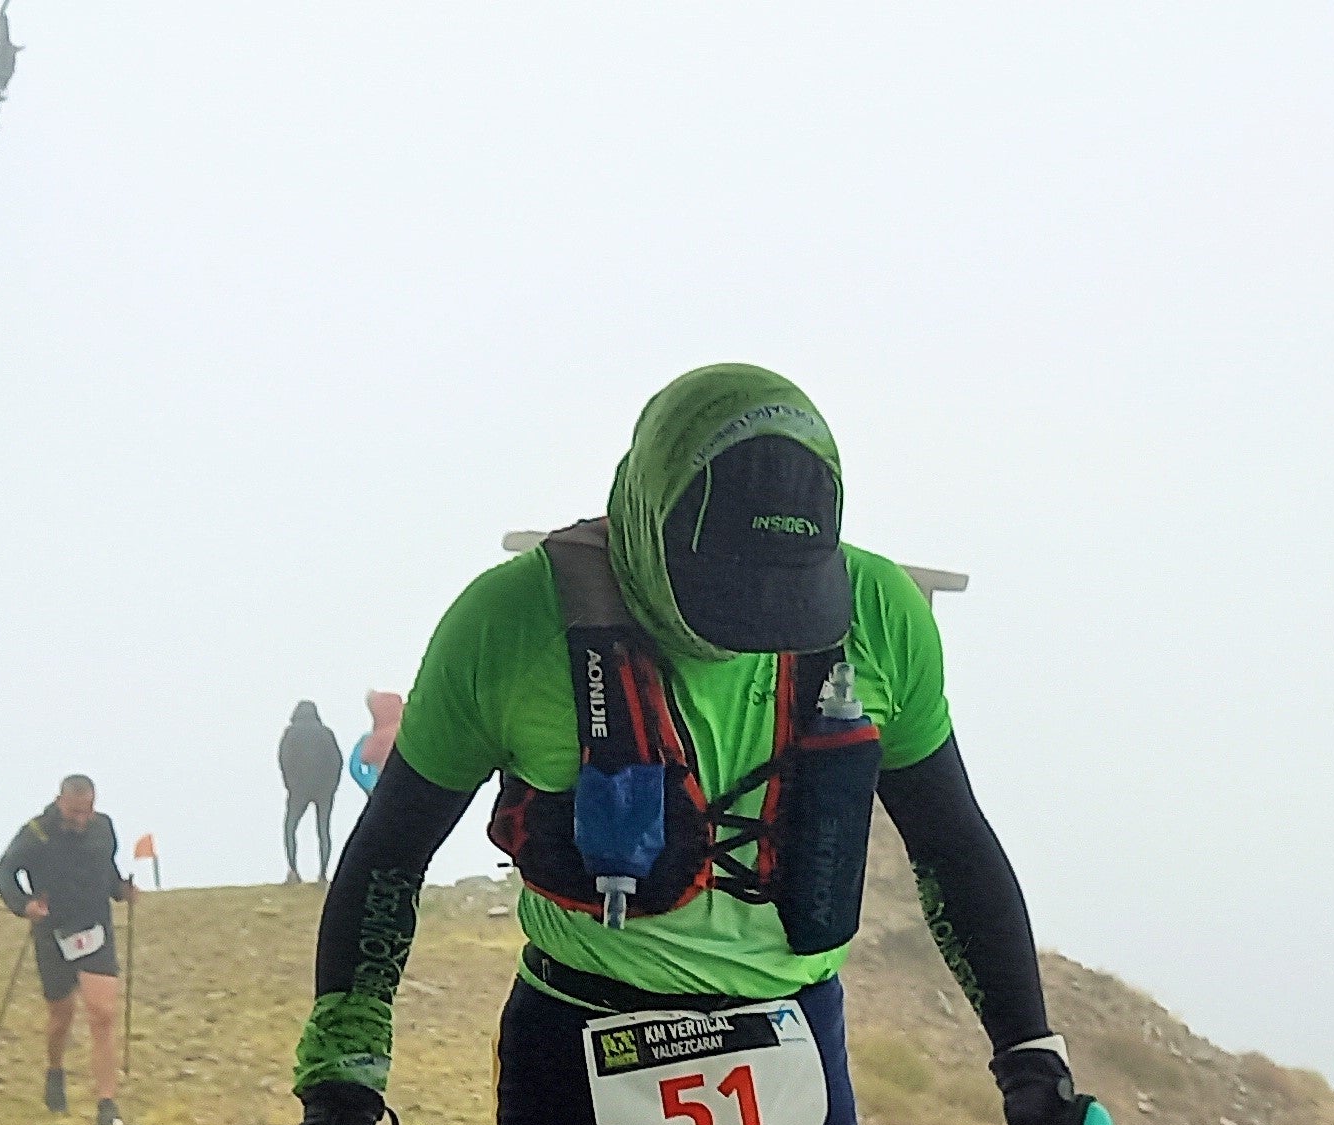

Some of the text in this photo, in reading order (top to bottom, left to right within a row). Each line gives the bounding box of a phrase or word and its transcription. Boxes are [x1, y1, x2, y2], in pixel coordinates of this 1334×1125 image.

[587, 649, 607, 737] AONIJIE
[644, 1016, 734, 1044] KM VERTICAL
[651, 1034, 723, 1059] VALDEZCARAY
